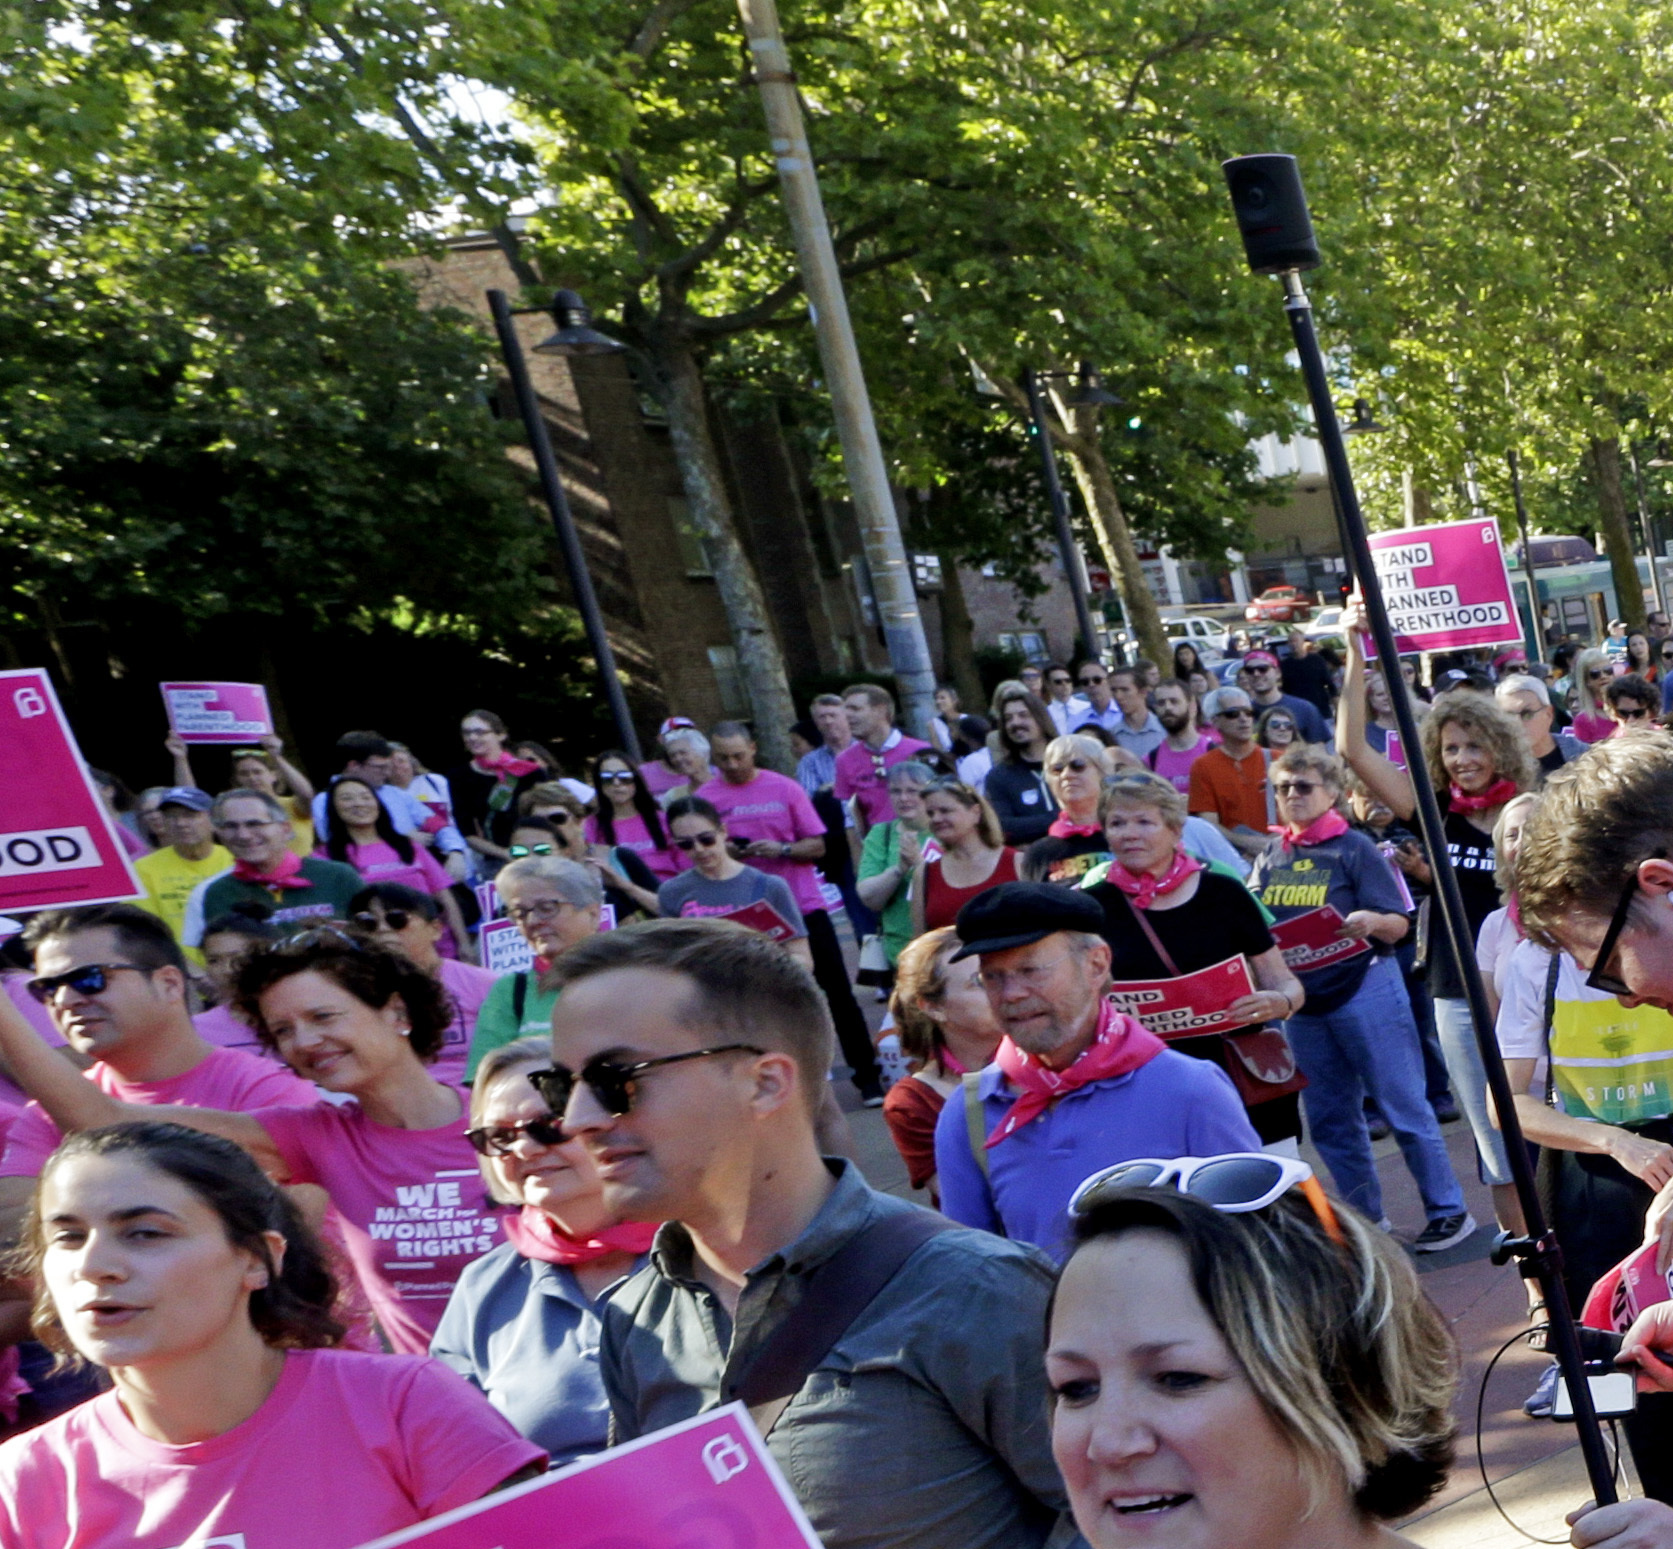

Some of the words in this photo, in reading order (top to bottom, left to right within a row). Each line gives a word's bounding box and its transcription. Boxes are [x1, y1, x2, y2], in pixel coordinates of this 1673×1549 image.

[0, 835, 82, 867] OD
[1261, 884, 1329, 906] STORM
[1586, 1081, 1656, 1101] STORM
[396, 1182, 462, 1207] WE
[375, 1207, 454, 1221] MARCH
[368, 1217, 499, 1240] WOMEN'S
[396, 1235, 494, 1258] RIGHTS
